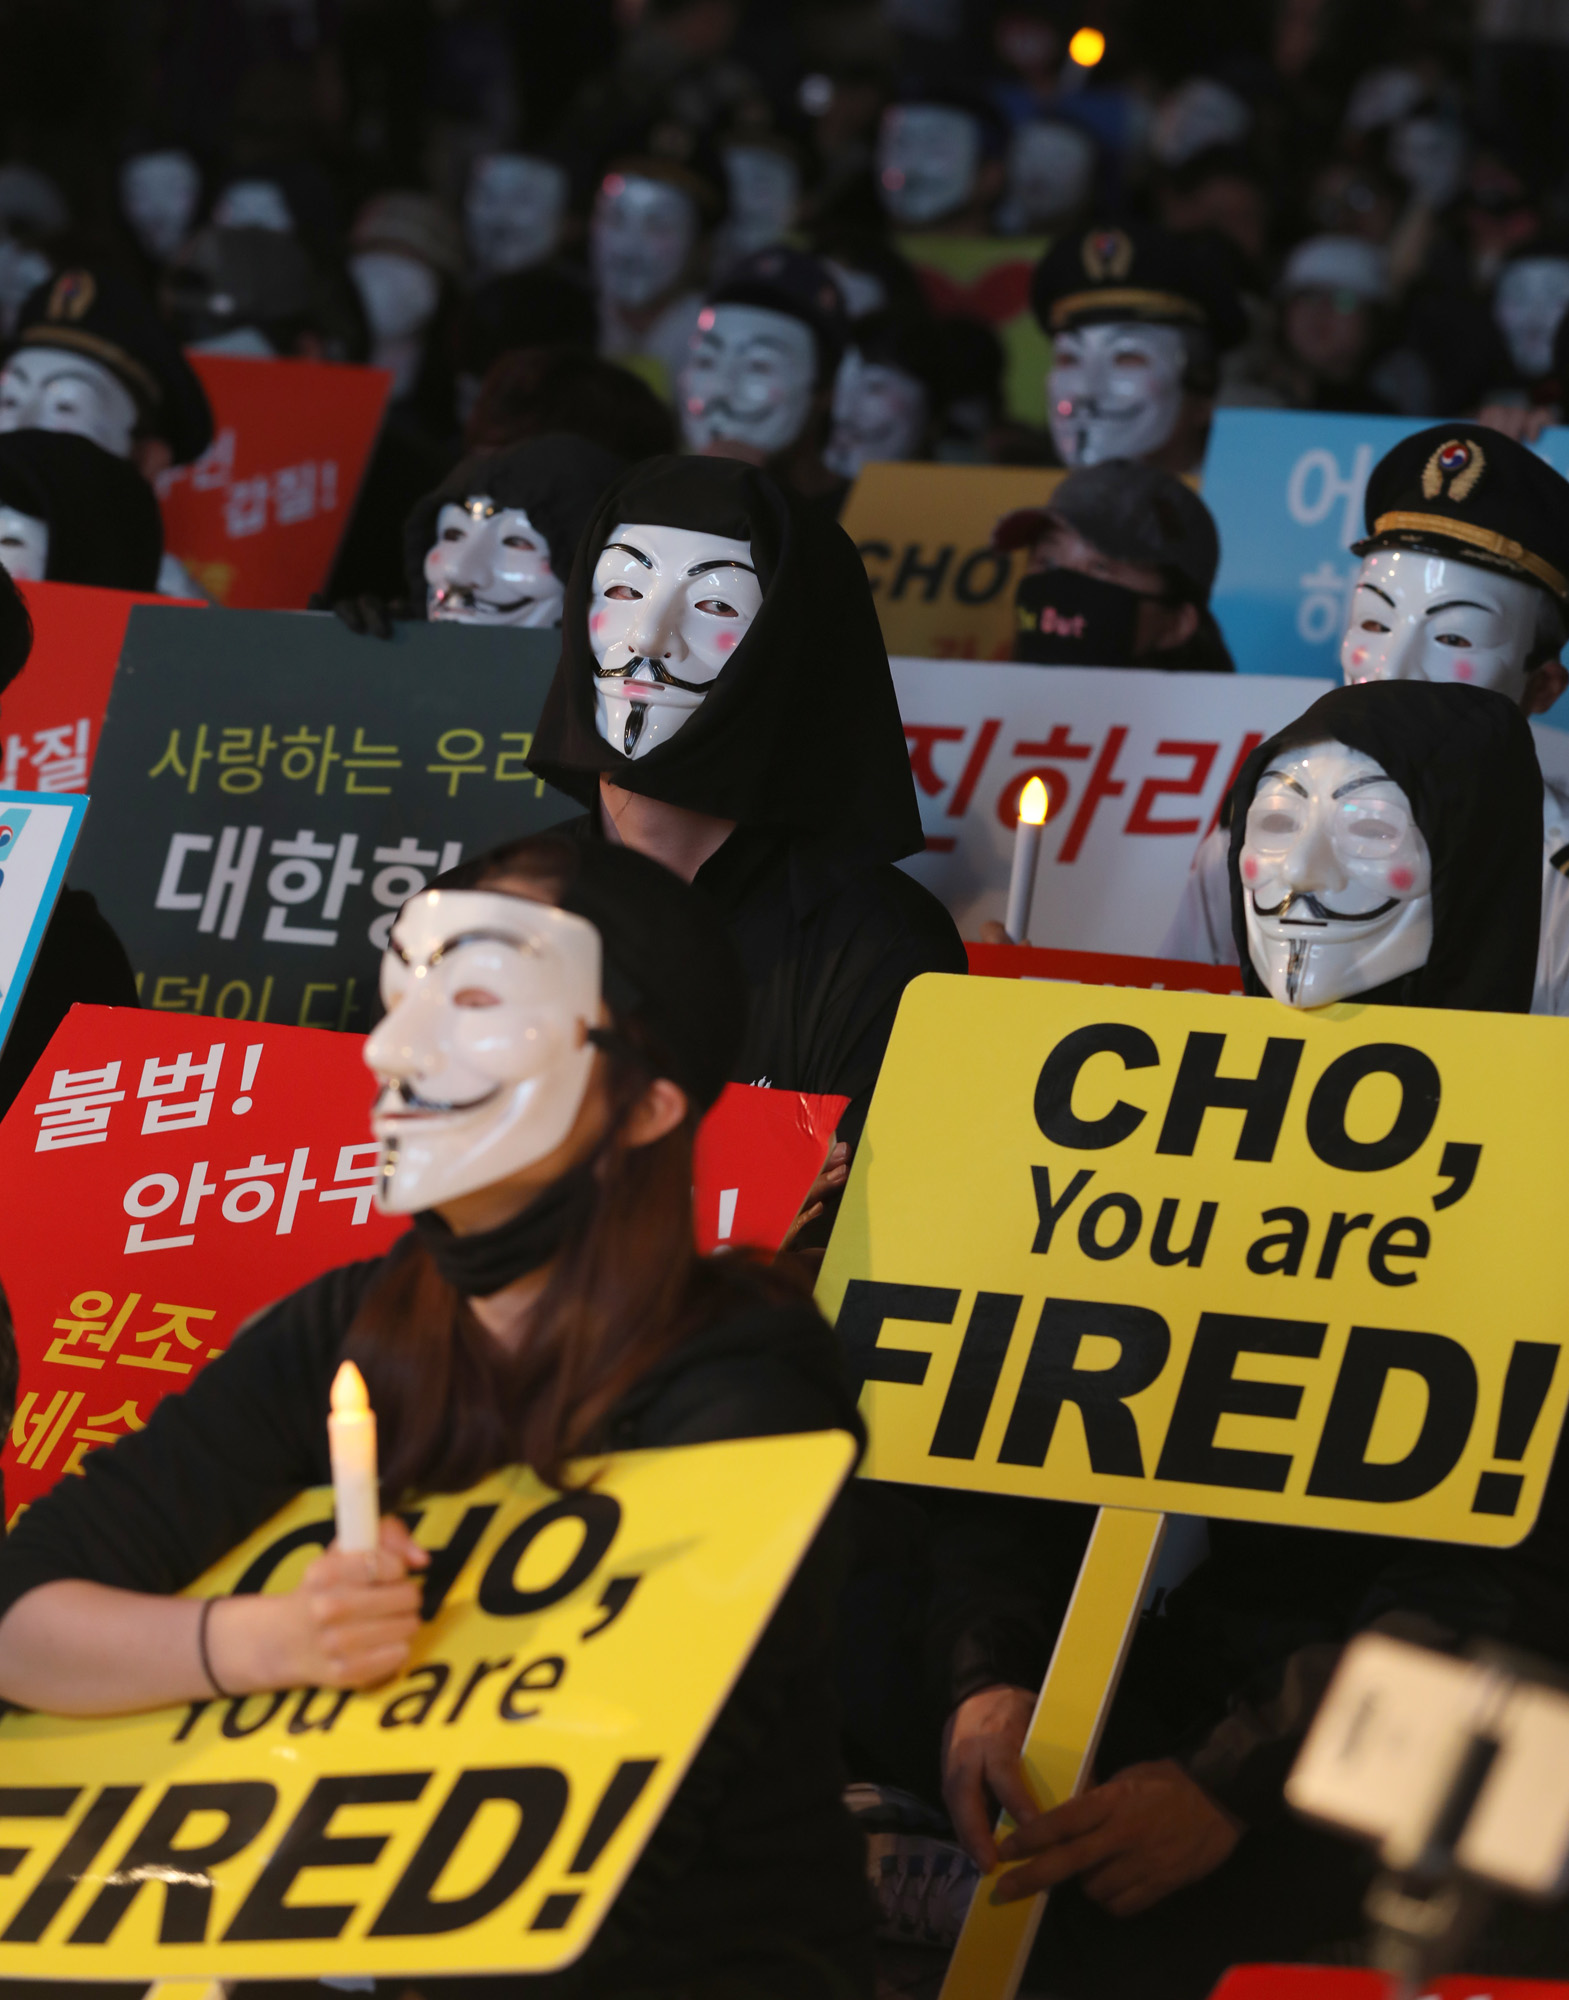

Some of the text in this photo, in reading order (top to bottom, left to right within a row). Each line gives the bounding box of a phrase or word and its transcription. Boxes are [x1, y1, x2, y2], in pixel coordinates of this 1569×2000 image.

[148, 724, 402, 796] 사랑하는
[34, 1043, 264, 1153] 불법!
[1033, 1022, 1483, 1212] CHO,
[1030, 1165, 1431, 1287] You are
[833, 1279, 1562, 1517] FIRED!
[379, 1656, 568, 1731] are
